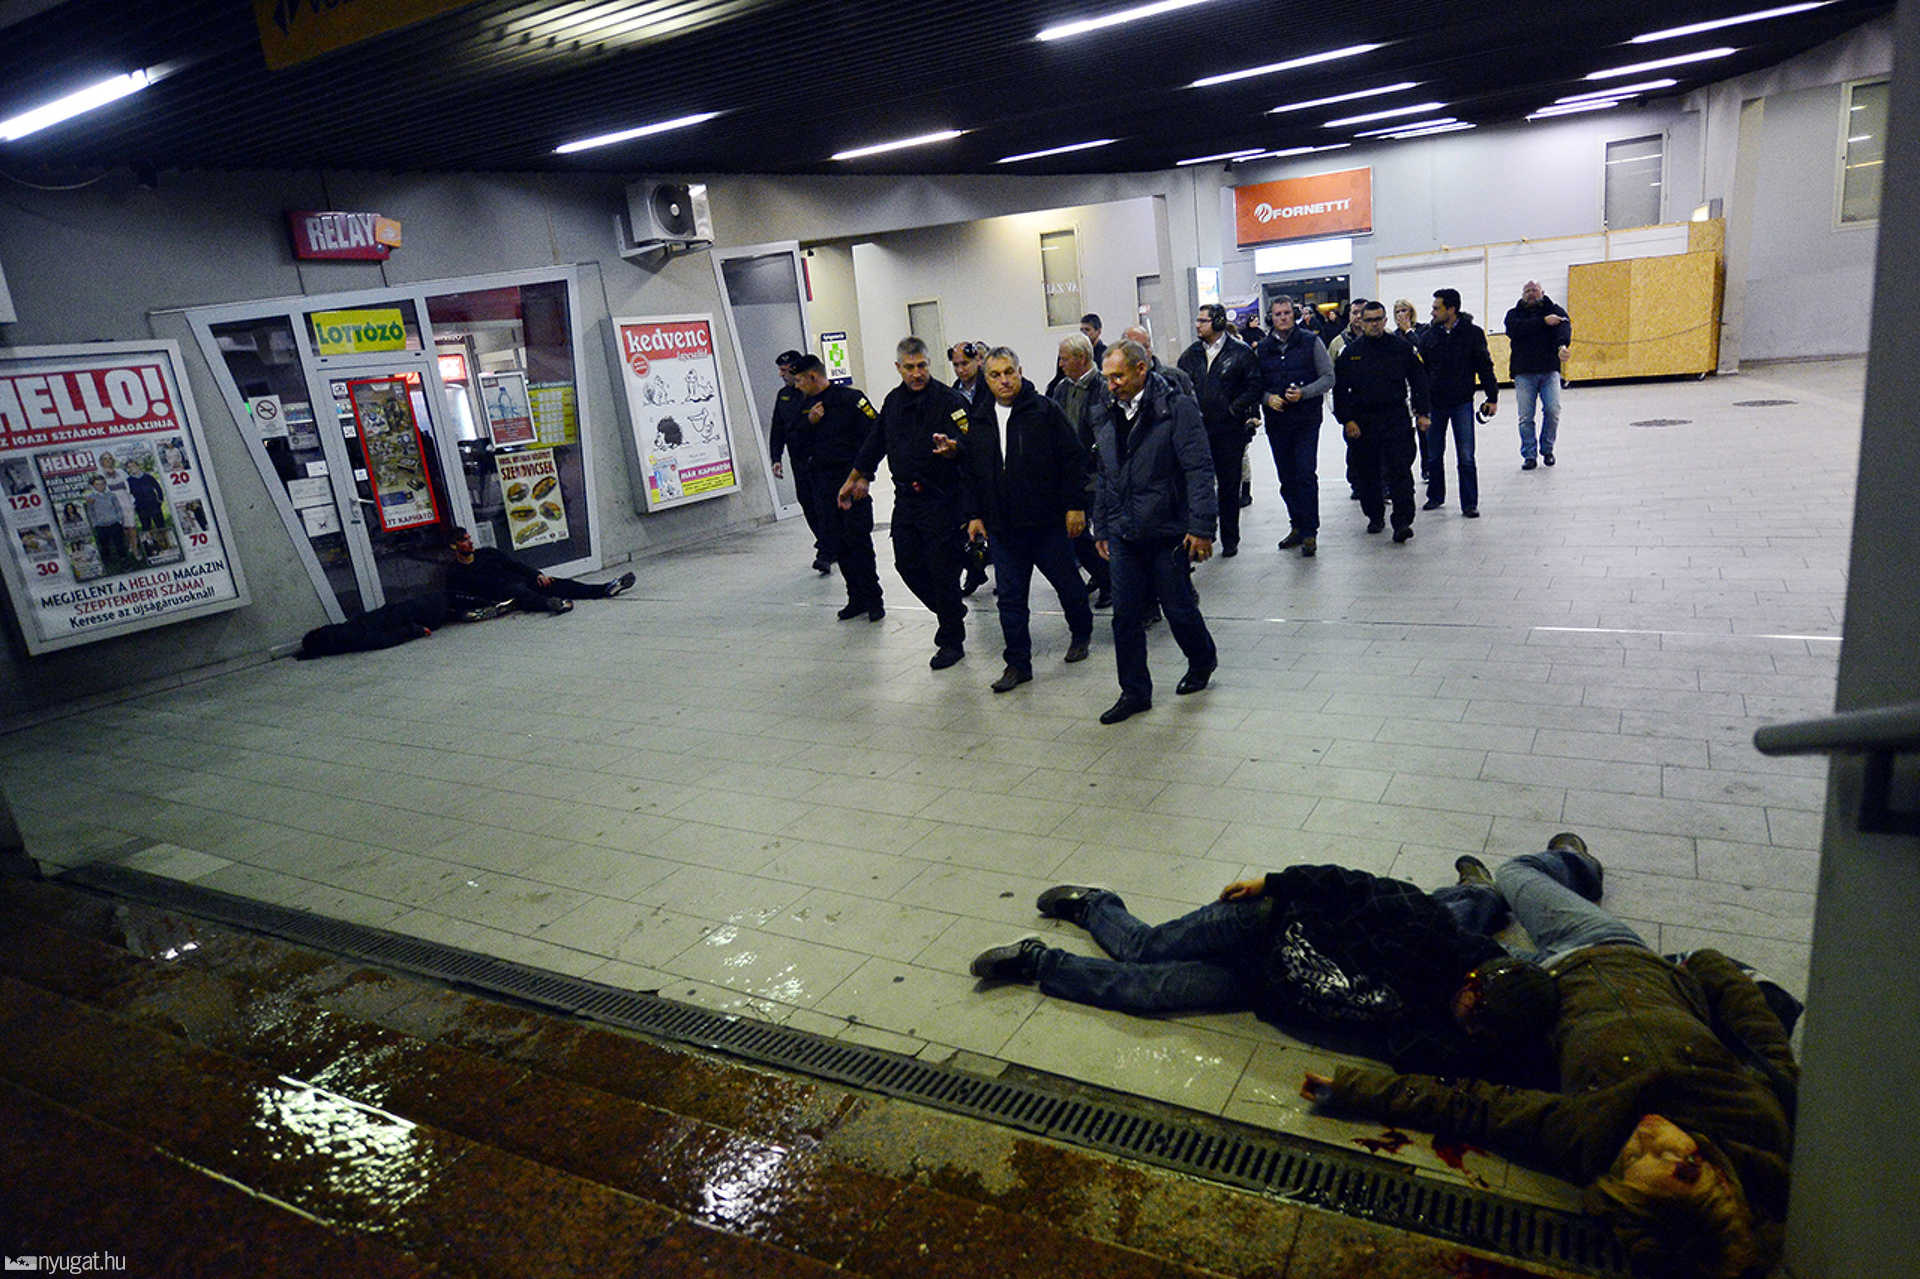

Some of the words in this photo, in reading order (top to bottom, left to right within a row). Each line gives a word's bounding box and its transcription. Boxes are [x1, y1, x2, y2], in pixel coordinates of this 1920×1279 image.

[1273, 198, 1352, 219] FORNETTI
[306, 213, 376, 251] RELAY
[315, 320, 404, 345] LOTTÓZÓ
[626, 328, 708, 353] kedvenc
[0, 367, 169, 433] HELLO!
[13, 433, 48, 445] IGAZI
[109, 419, 175, 433] MAGAZINJA
[39, 451, 95, 472] HELLO!
[170, 472, 190, 485] 20
[9, 494, 41, 510] 120
[189, 533, 208, 547] 70
[36, 562, 59, 576] 30
[41, 583, 113, 609] MEGJELENT
[118, 581, 128, 592] A
[128, 571, 170, 590] HELLO!
[173, 560, 225, 580] MAGAZIN
[74, 587, 158, 616] SZEPTEMBERI
[69, 612, 115, 629] Keresse
[118, 608, 130, 618] az
